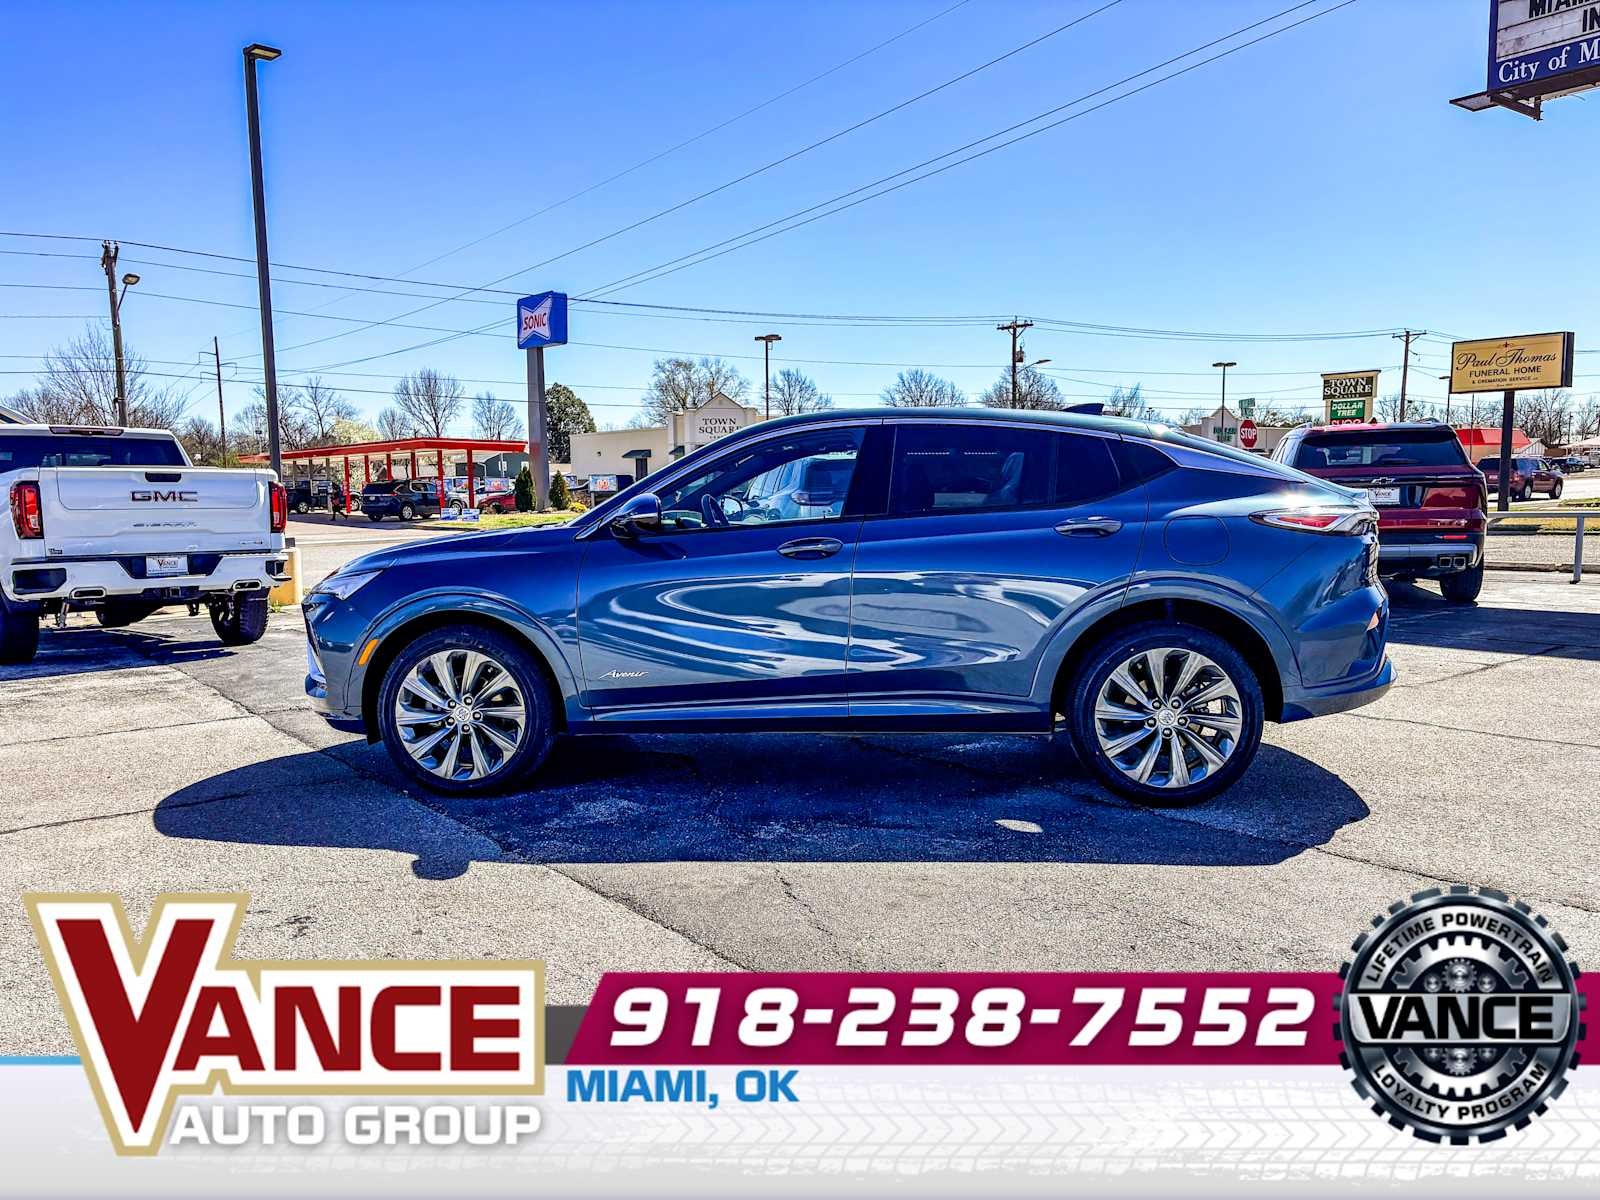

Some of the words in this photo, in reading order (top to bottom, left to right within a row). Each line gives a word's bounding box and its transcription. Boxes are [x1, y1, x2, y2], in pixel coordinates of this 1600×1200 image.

[1498, 60, 1540, 83] City
[1548, 46, 1571, 71] of
[523, 312, 547, 331] SONIC
[1456, 352, 1497, 371] Paul
[1495, 348, 1556, 368] Thomas
[1469, 368, 1511, 378] FUNERAL
[1513, 365, 1542, 375] HOME
[1330, 377, 1366, 387] TOWN
[1324, 384, 1372, 396] SQUARE
[1332, 402, 1363, 410] DOLLAR
[702, 417, 736, 425] TOWN
[698, 425, 742, 434] SQUAR
[1240, 428, 1257, 439] STOP
[131, 490, 199, 502] GMC
[600, 669, 649, 679] Avenir
